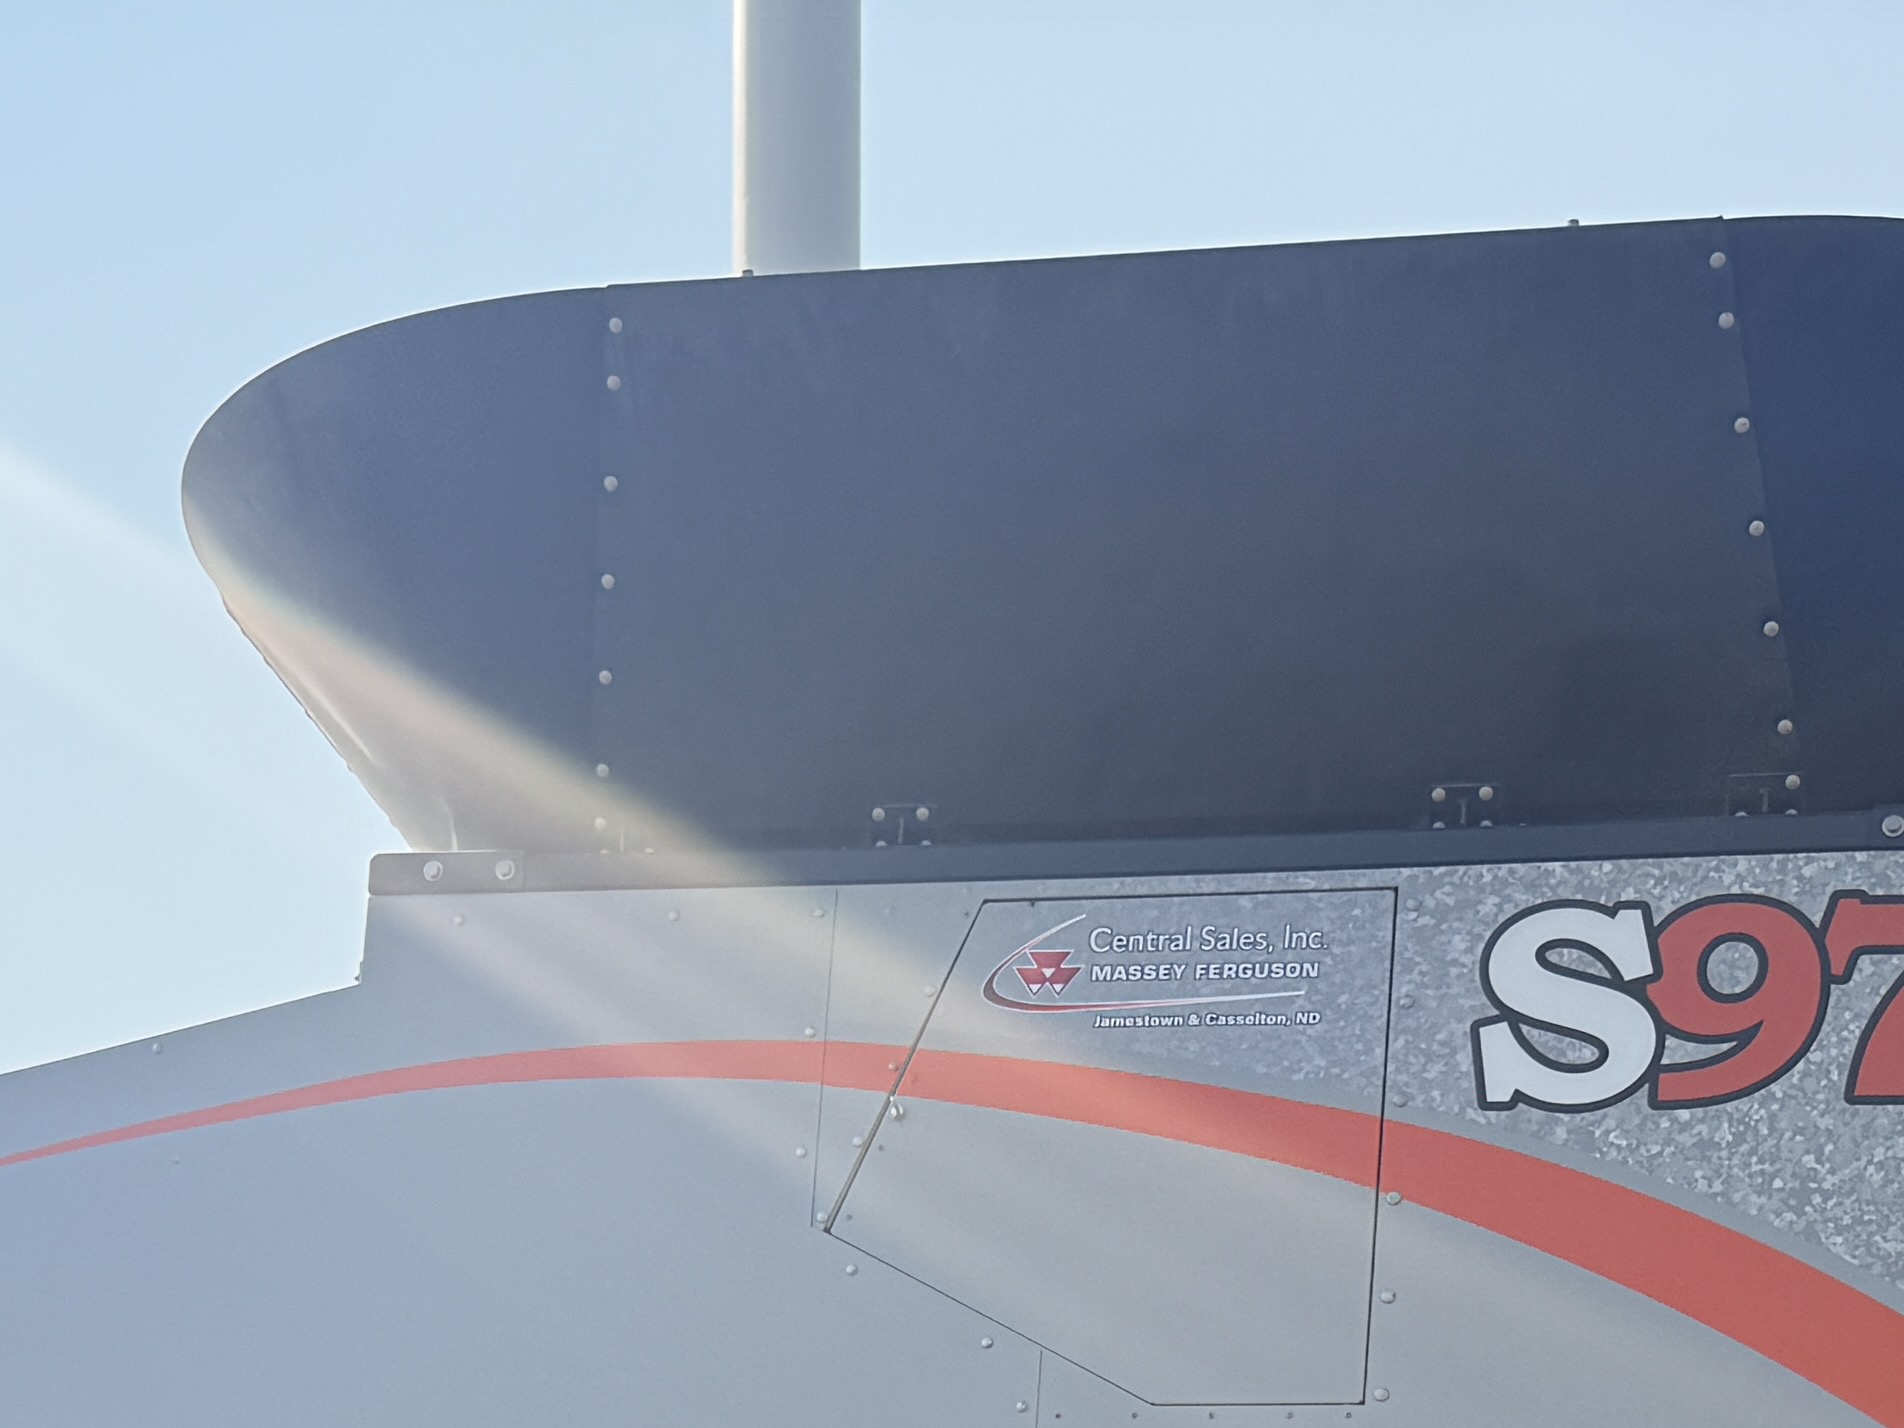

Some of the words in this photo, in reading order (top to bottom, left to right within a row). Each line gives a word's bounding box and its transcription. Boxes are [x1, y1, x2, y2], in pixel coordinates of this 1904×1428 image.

[1089, 925, 1192, 953] Central
[1200, 925, 1275, 953] Sales,
[1283, 924, 1329, 951] Inc.
[1090, 964, 1186, 983] MASSEY
[1195, 962, 1320, 980] FERGUSON
[1093, 1014, 1184, 1029] Jamestown
[1187, 1013, 1202, 1027] &
[1295, 1011, 1322, 1026] ND
